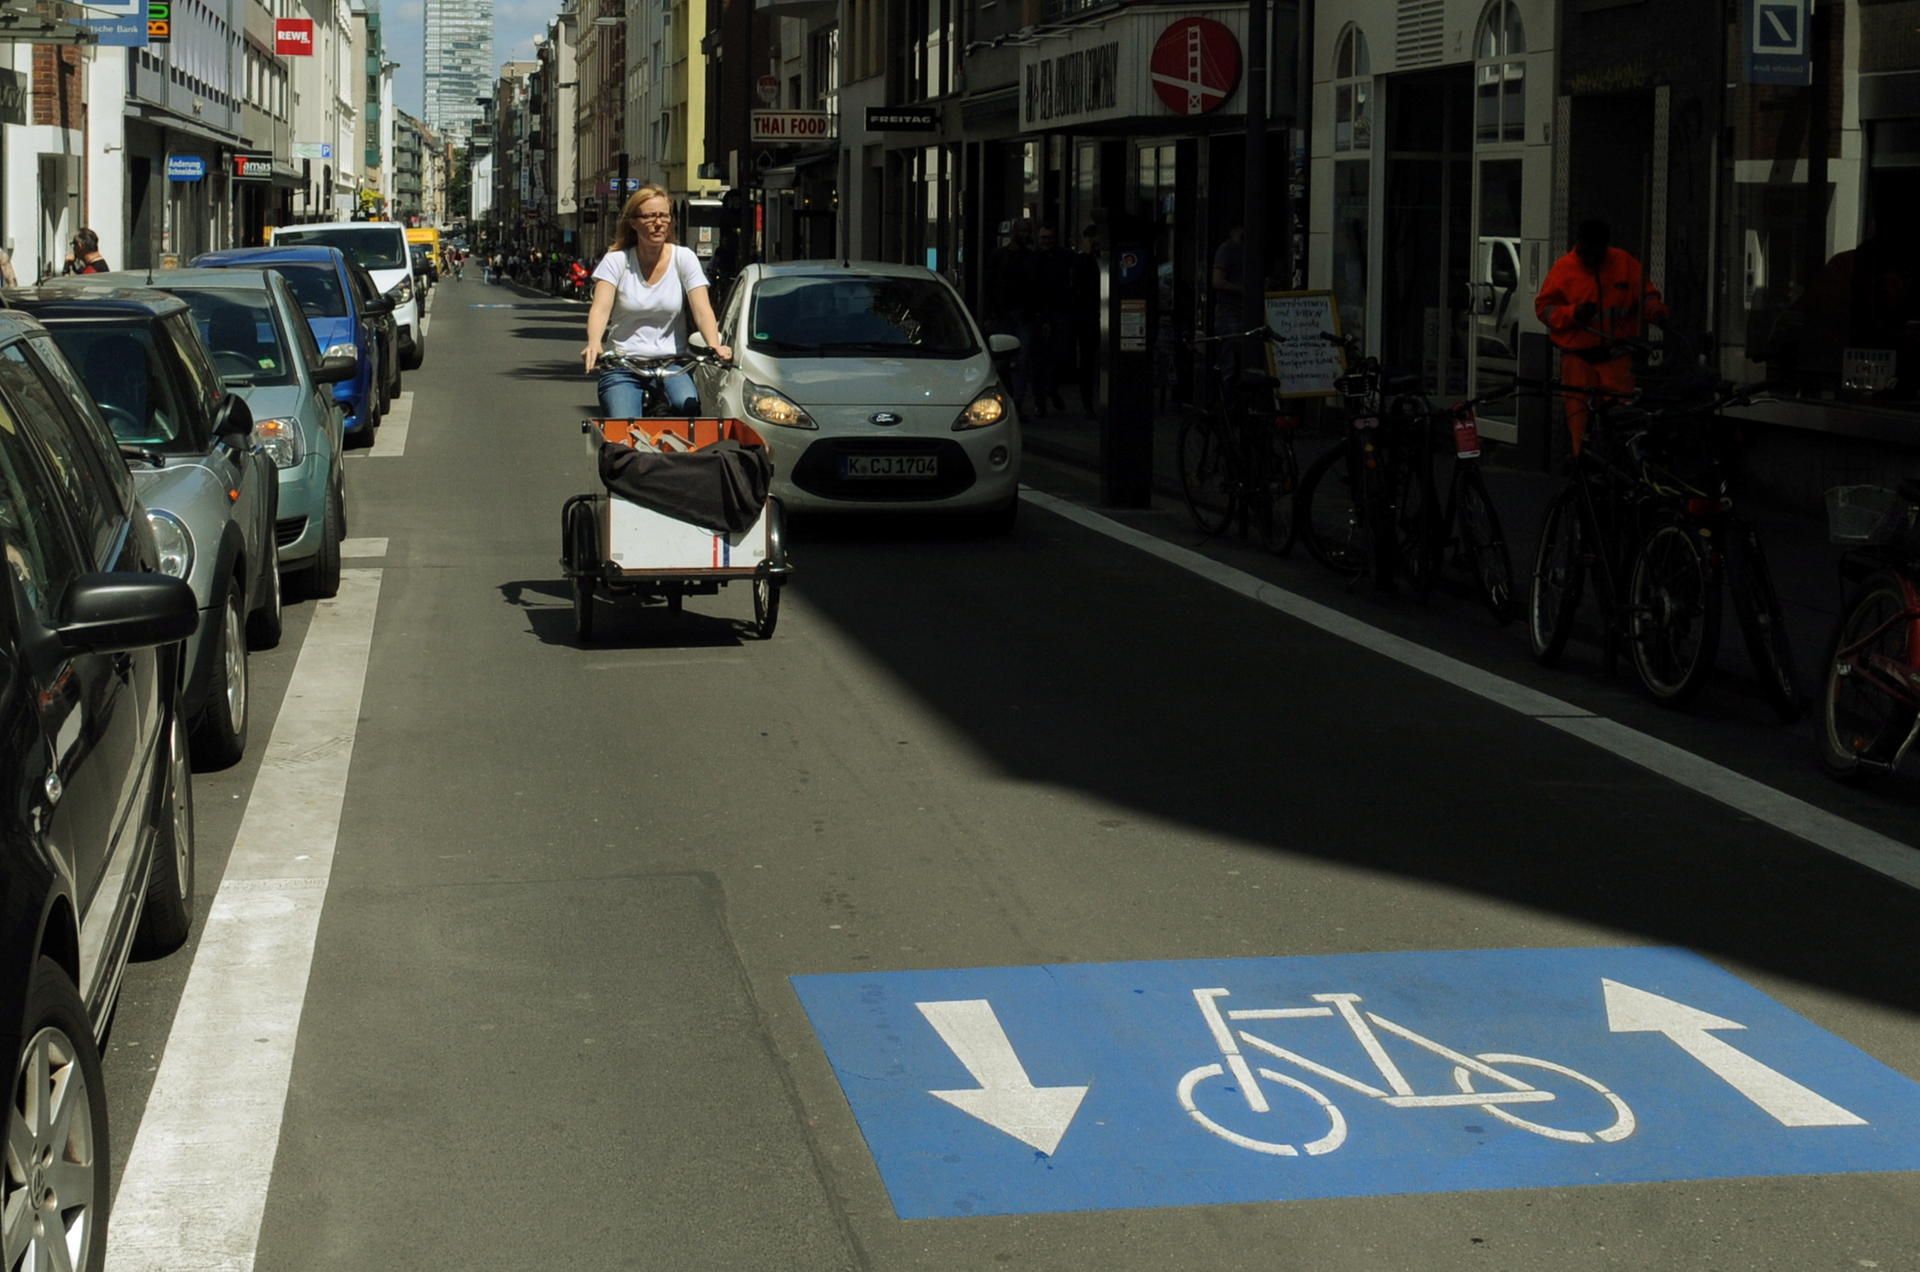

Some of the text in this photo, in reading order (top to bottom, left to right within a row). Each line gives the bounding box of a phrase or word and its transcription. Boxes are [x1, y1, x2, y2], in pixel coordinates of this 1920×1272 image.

[117, 25, 138, 33] Bank
[277, 31, 308, 41] REWE
[753, 118, 826, 135] THAI FOOD
[234, 156, 271, 176] Tamas
[848, 458, 860, 474] K
